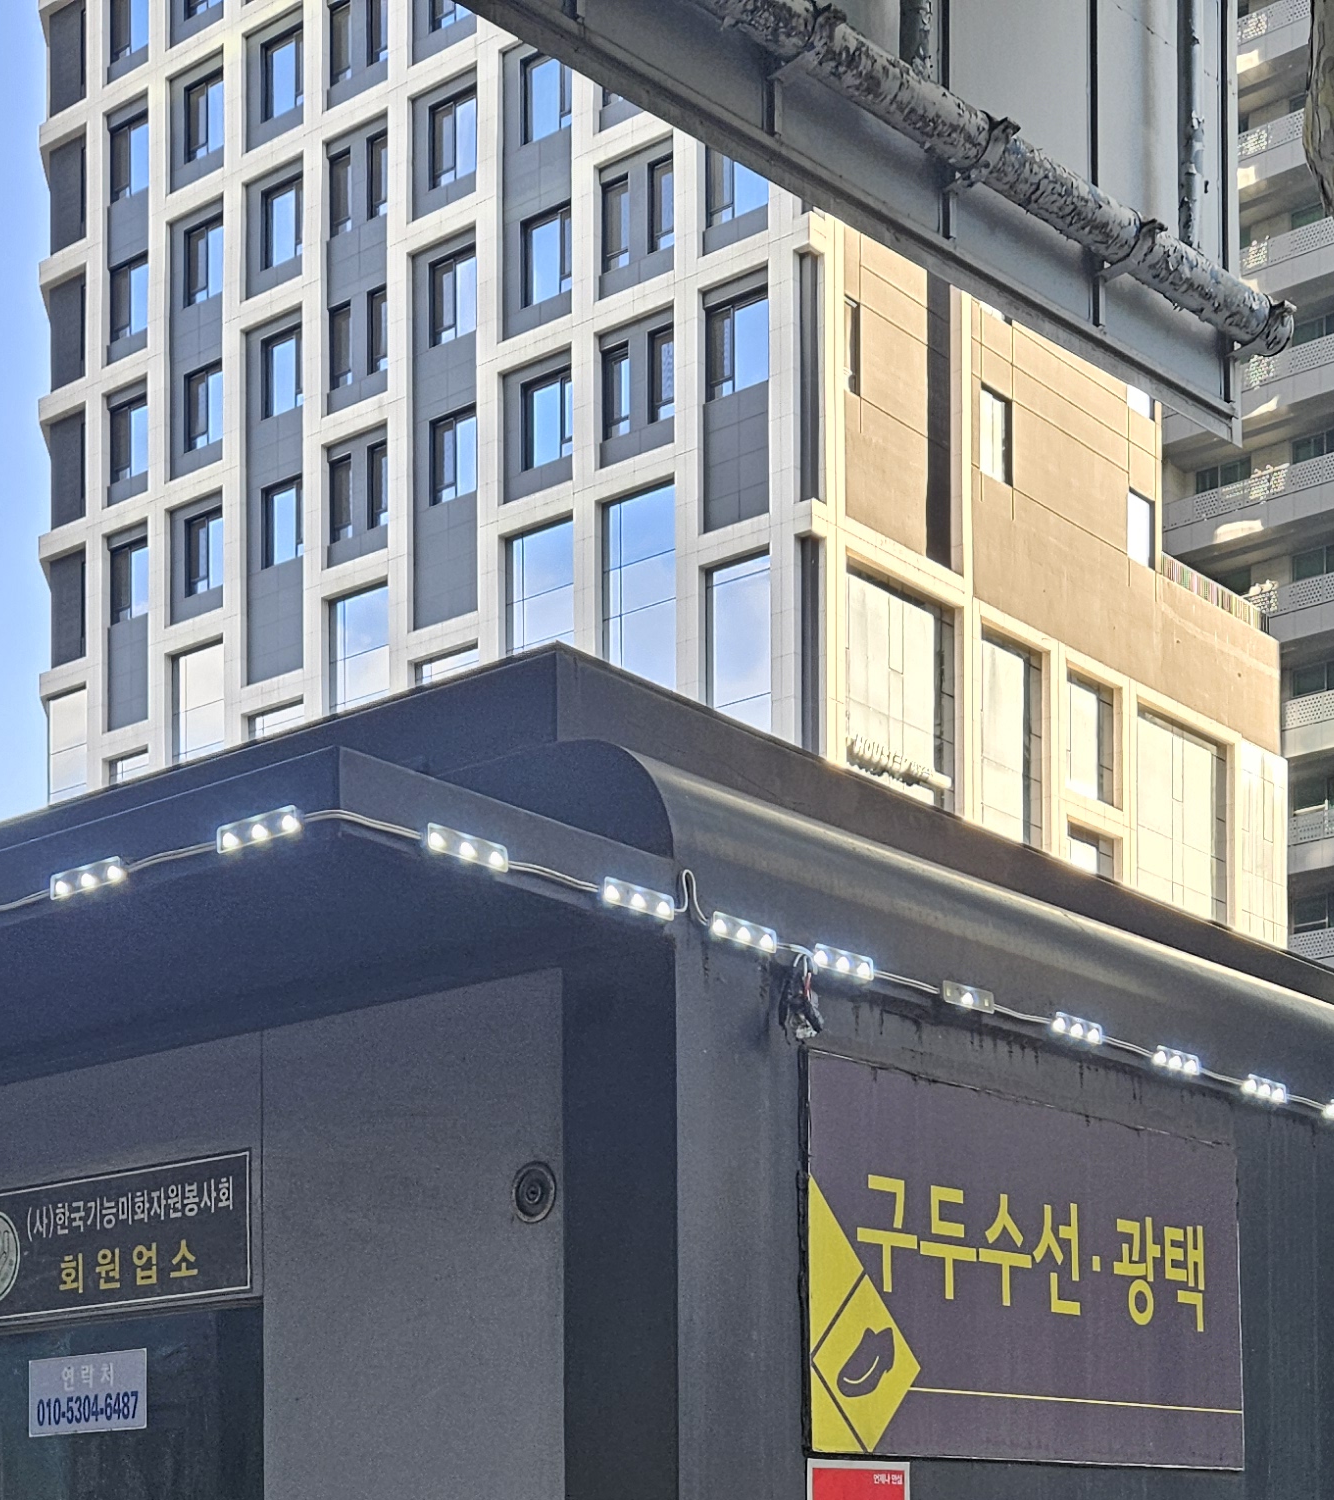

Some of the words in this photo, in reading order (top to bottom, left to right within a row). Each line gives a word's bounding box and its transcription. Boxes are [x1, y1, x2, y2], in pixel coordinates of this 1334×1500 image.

[26, 1176, 233, 1241] (사)한국기능미화자원봉사회
[856, 1174, 1205, 1332] 구두수선·광택
[36, 1390, 139, 1427] 010-5304-6487
